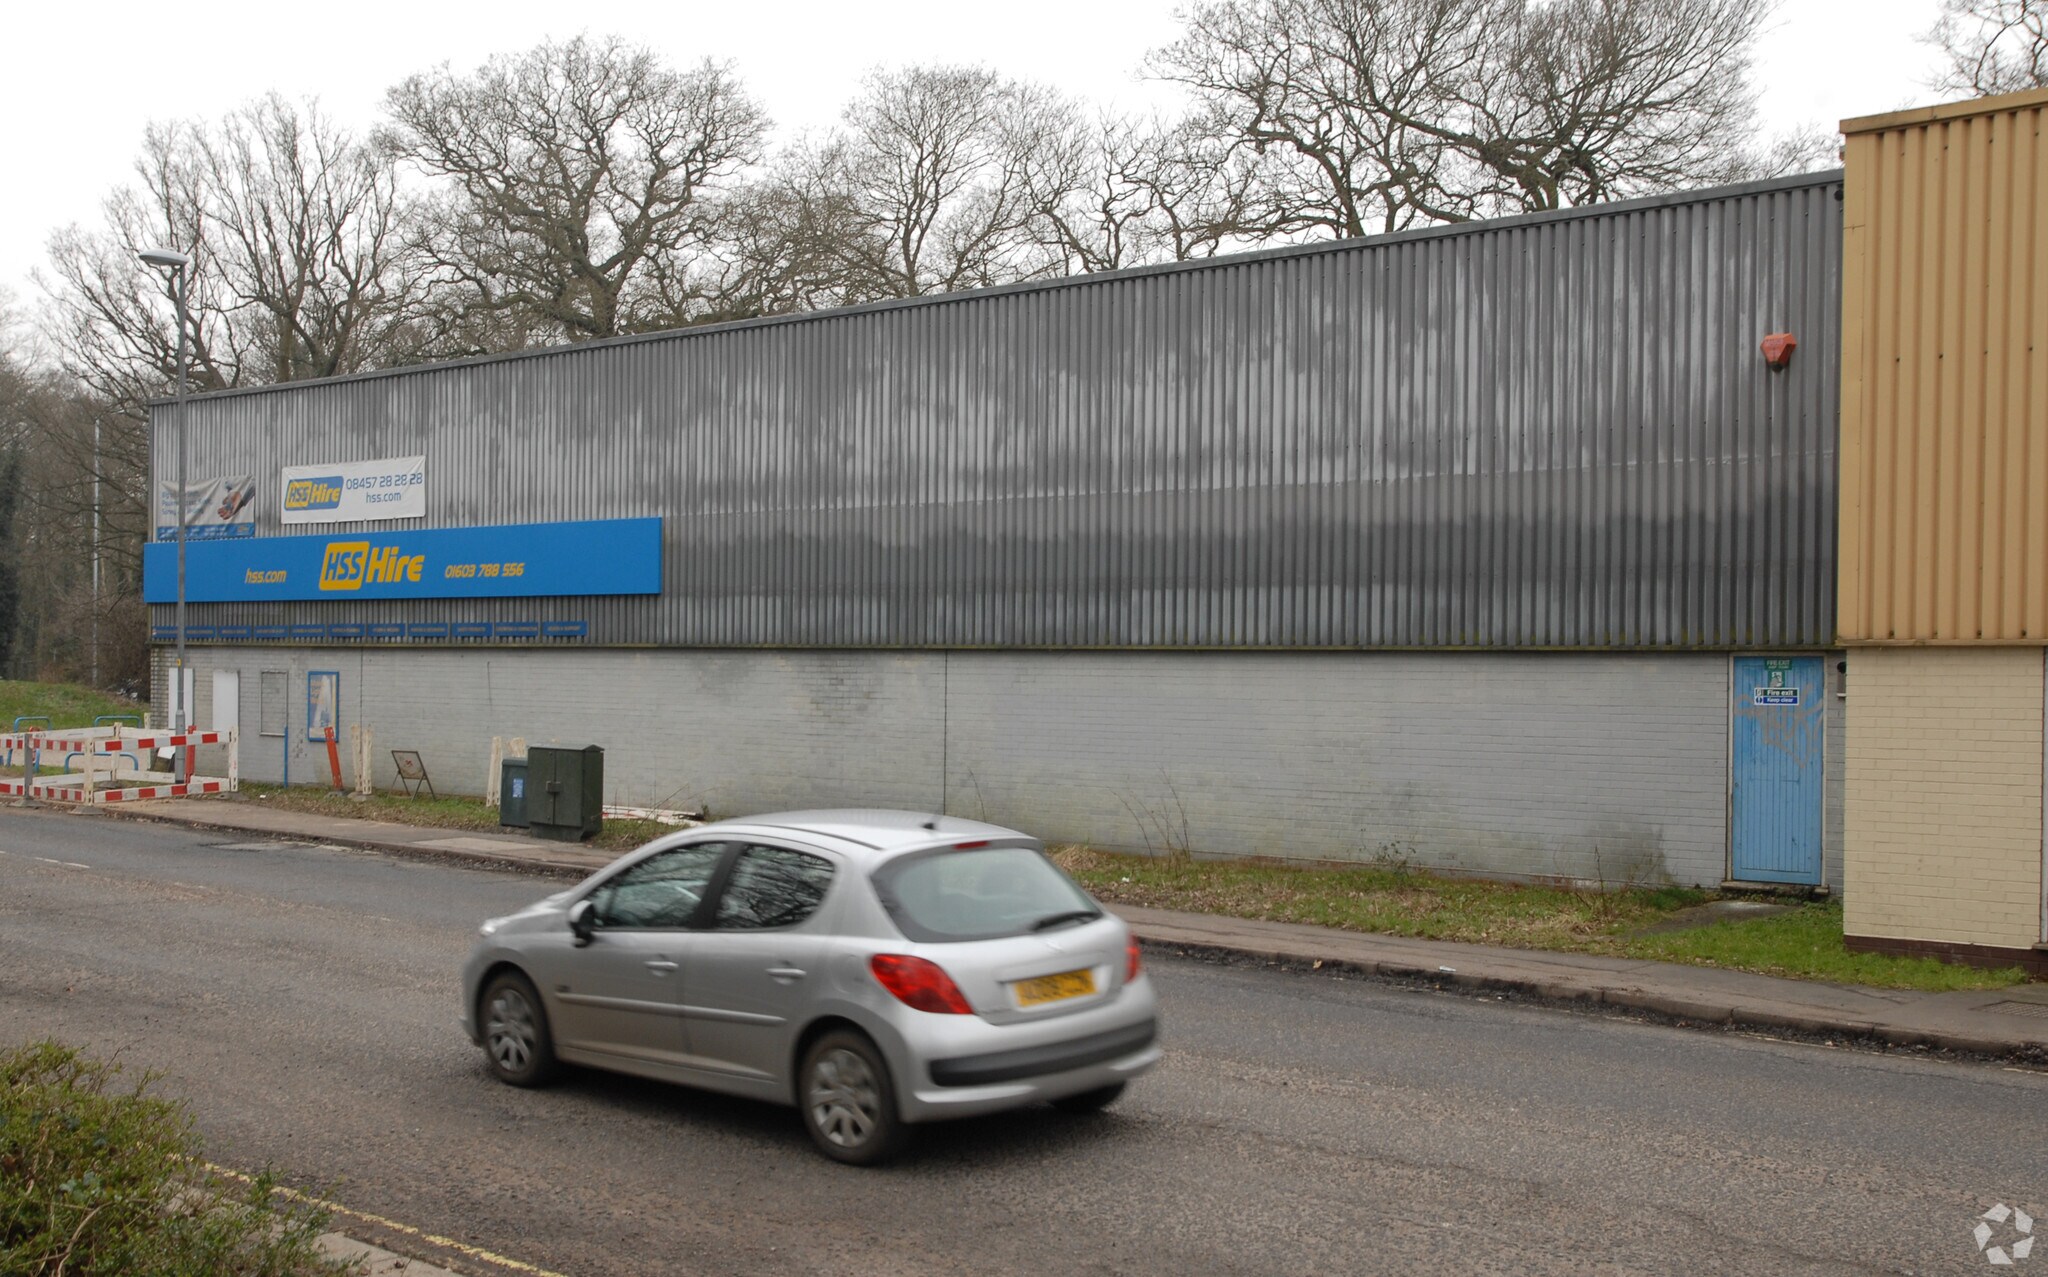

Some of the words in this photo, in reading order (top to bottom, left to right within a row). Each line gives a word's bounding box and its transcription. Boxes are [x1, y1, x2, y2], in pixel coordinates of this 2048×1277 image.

[345, 476, 377, 490] 08457
[379, 475, 393, 488] 28
[394, 474, 408, 487] 28
[409, 472, 423, 485] 28
[288, 484, 308, 503] HSS
[310, 483, 341, 503] Hire
[365, 491, 402, 503] hss.com
[323, 549, 364, 583] HSS
[365, 546, 425, 583] Hire
[444, 564, 476, 578] 01603
[478, 563, 500, 577] 788
[502, 562, 525, 576] 556
[244, 568, 287, 584] hss.com
